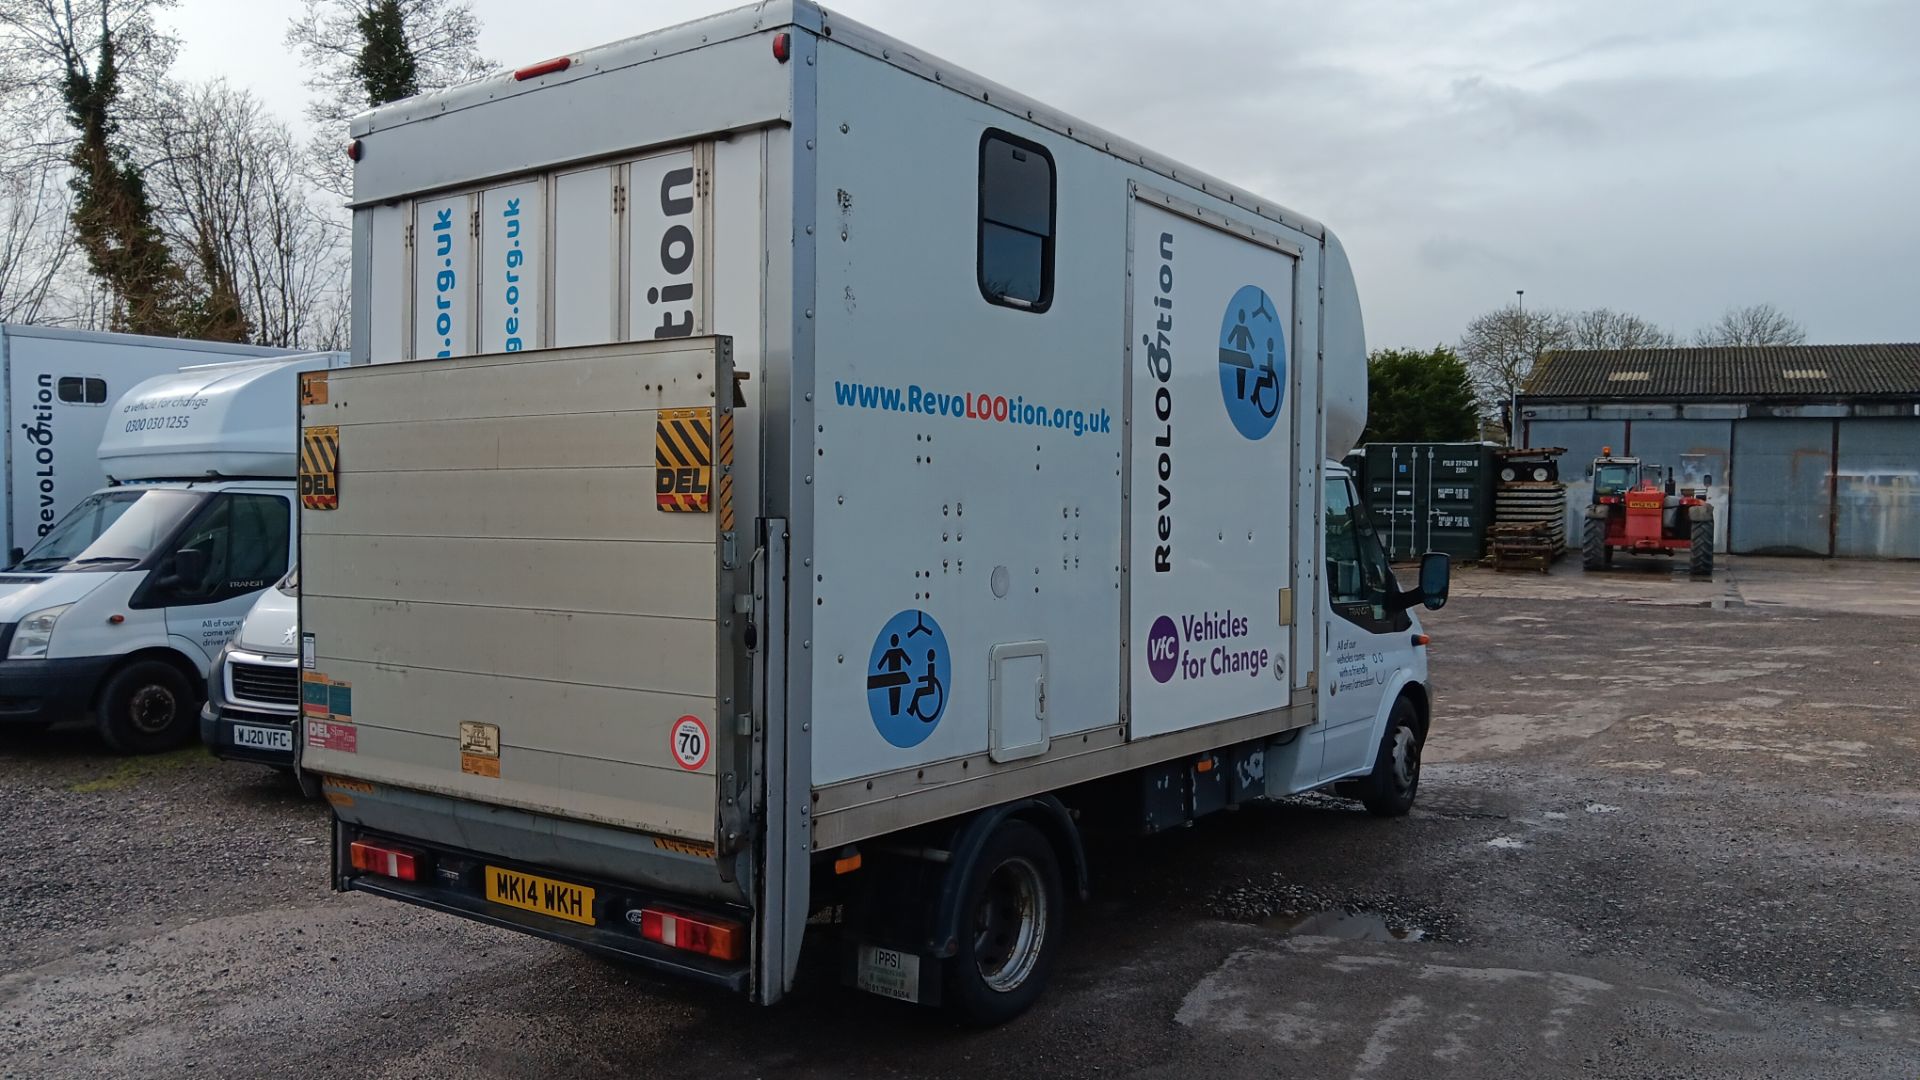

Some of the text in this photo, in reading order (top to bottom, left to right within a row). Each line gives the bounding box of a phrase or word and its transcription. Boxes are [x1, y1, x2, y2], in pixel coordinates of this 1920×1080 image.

[123, 398, 208, 413] a vehicle for change
[835, 381, 1111, 437] www.RevoLOOtion.org.uk
[125, 415, 190, 433] 0300 030 1255
[301, 474, 335, 496] DEL
[657, 468, 708, 494] DEL
[229, 580, 264, 588] TRANSIT
[202, 620, 213, 628] All
[213, 619, 221, 627] of
[1181, 609, 1248, 642] Vehicles
[1151, 635, 1176, 661] VfC
[1181, 645, 1268, 680] for Change
[238, 727, 287, 747] WJ20 VFC
[309, 722, 331, 738] DEL
[679, 732, 701, 756] 70
[497, 872, 539, 907] MK14
[544, 882, 583, 917] WKH
